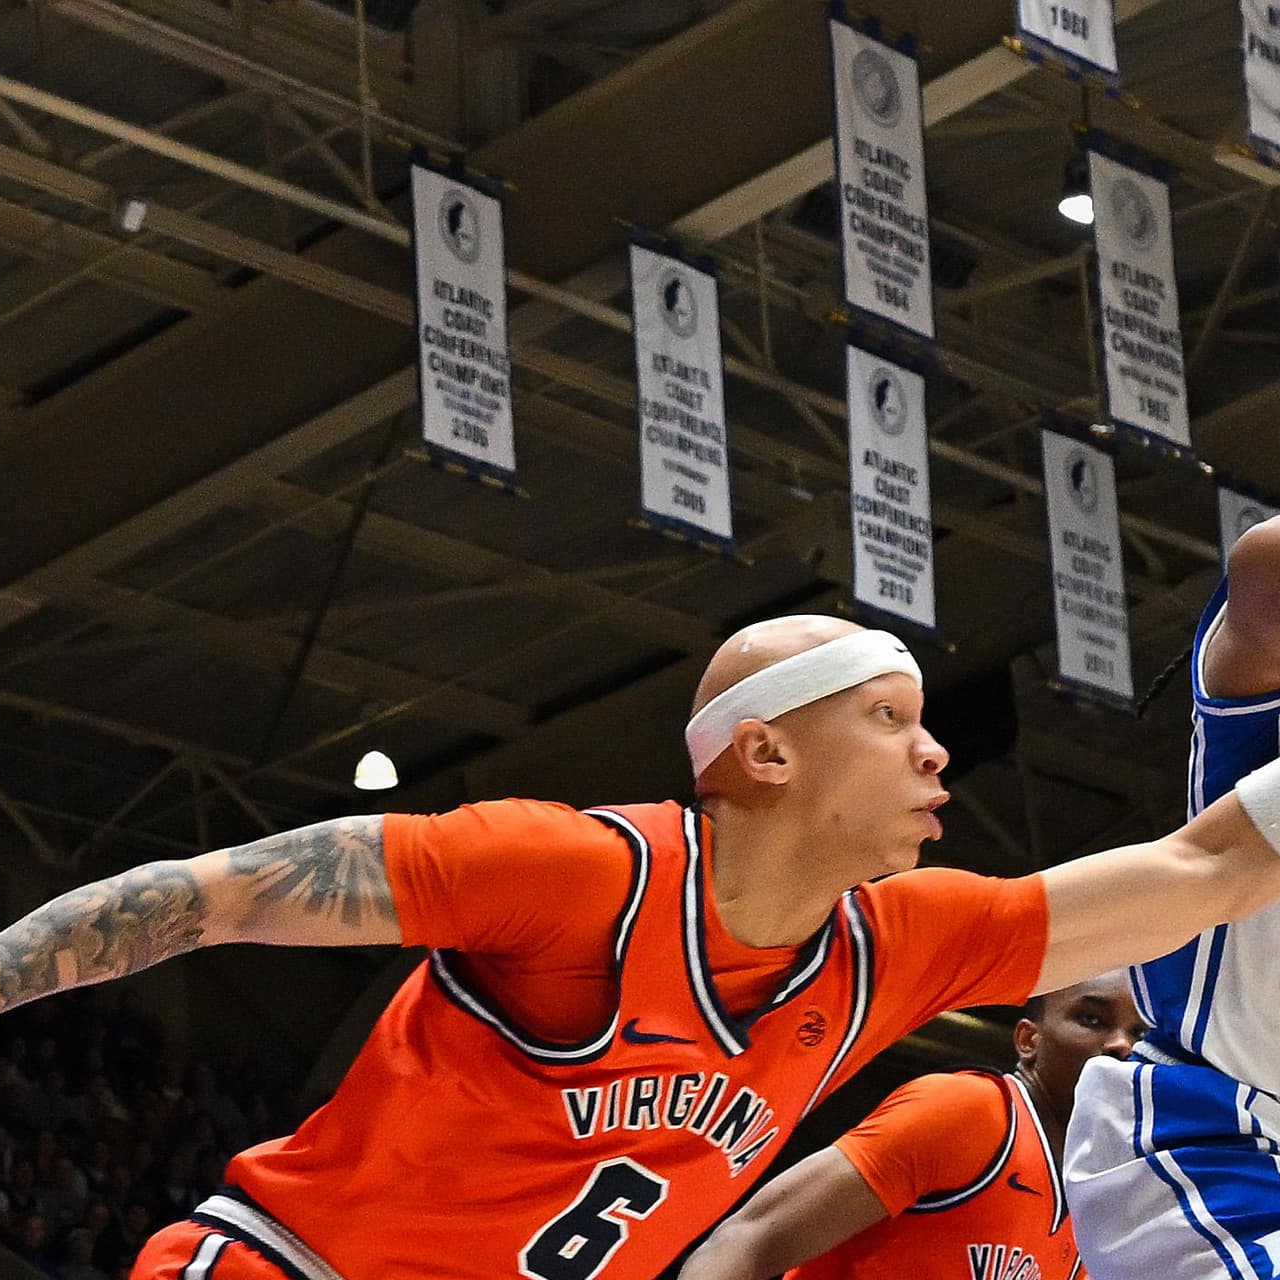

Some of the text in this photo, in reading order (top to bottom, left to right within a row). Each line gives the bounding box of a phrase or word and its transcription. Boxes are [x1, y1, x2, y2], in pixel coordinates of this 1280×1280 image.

[433, 276, 493, 319] ATLANTIC
[424, 325, 510, 376] CONFERENCE
[428, 351, 506, 397] CHAMPIONS
[864, 448, 918, 486] ATLANTIC
[853, 493, 932, 537] CONFERENCE
[858, 519, 929, 560] CHAMPIONS
